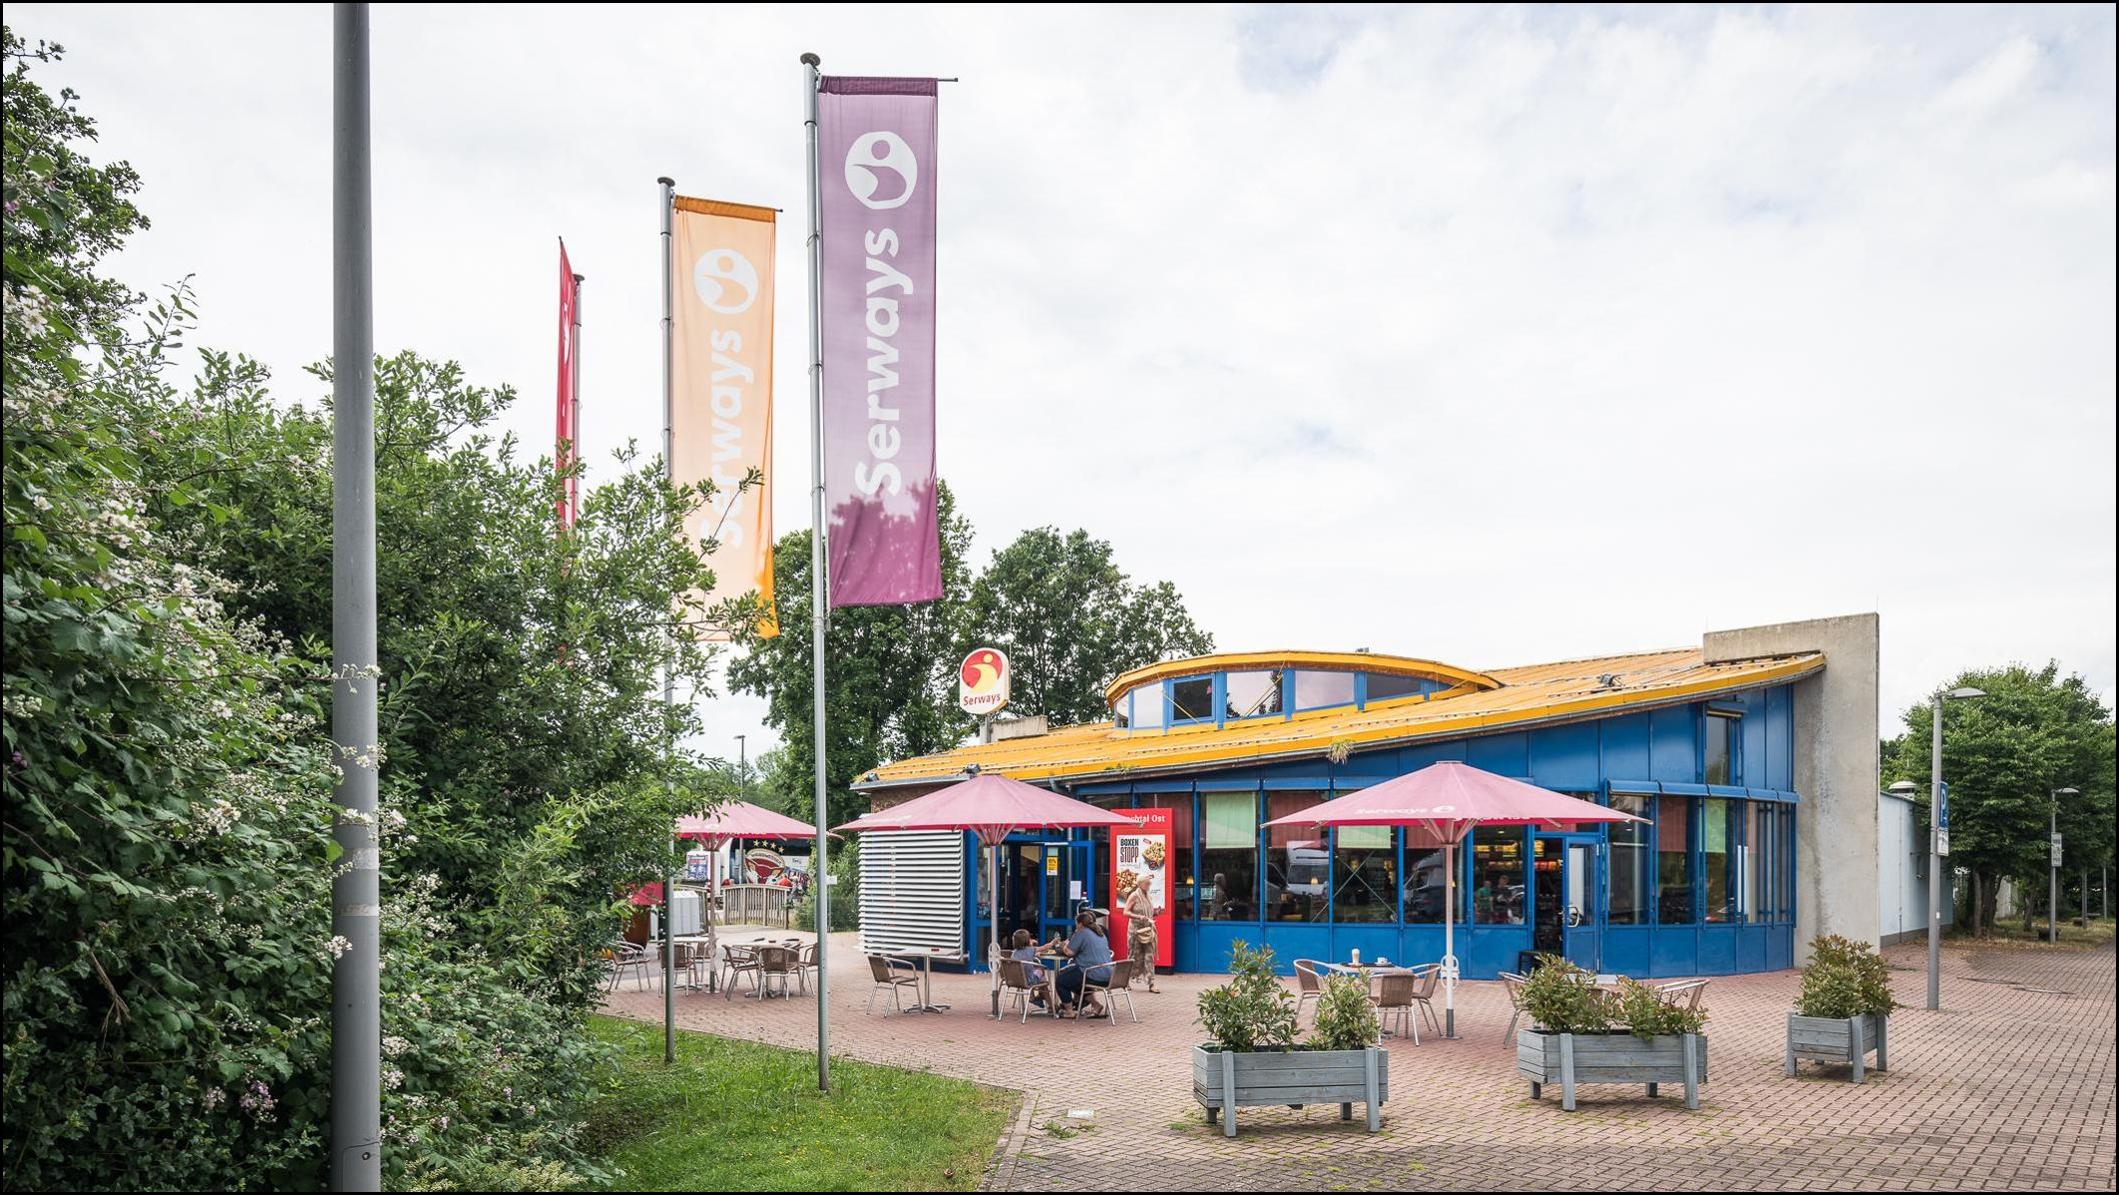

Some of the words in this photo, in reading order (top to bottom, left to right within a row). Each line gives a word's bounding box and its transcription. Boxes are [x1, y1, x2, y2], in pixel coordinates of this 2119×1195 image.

[855, 227, 913, 497] Serways
[699, 328, 754, 548] Serways
[963, 694, 1001, 706] Serways
[1151, 814, 1165, 823] Ost
[1120, 838, 1139, 847] BOXEN
[1120, 847, 1139, 863] STOPP
